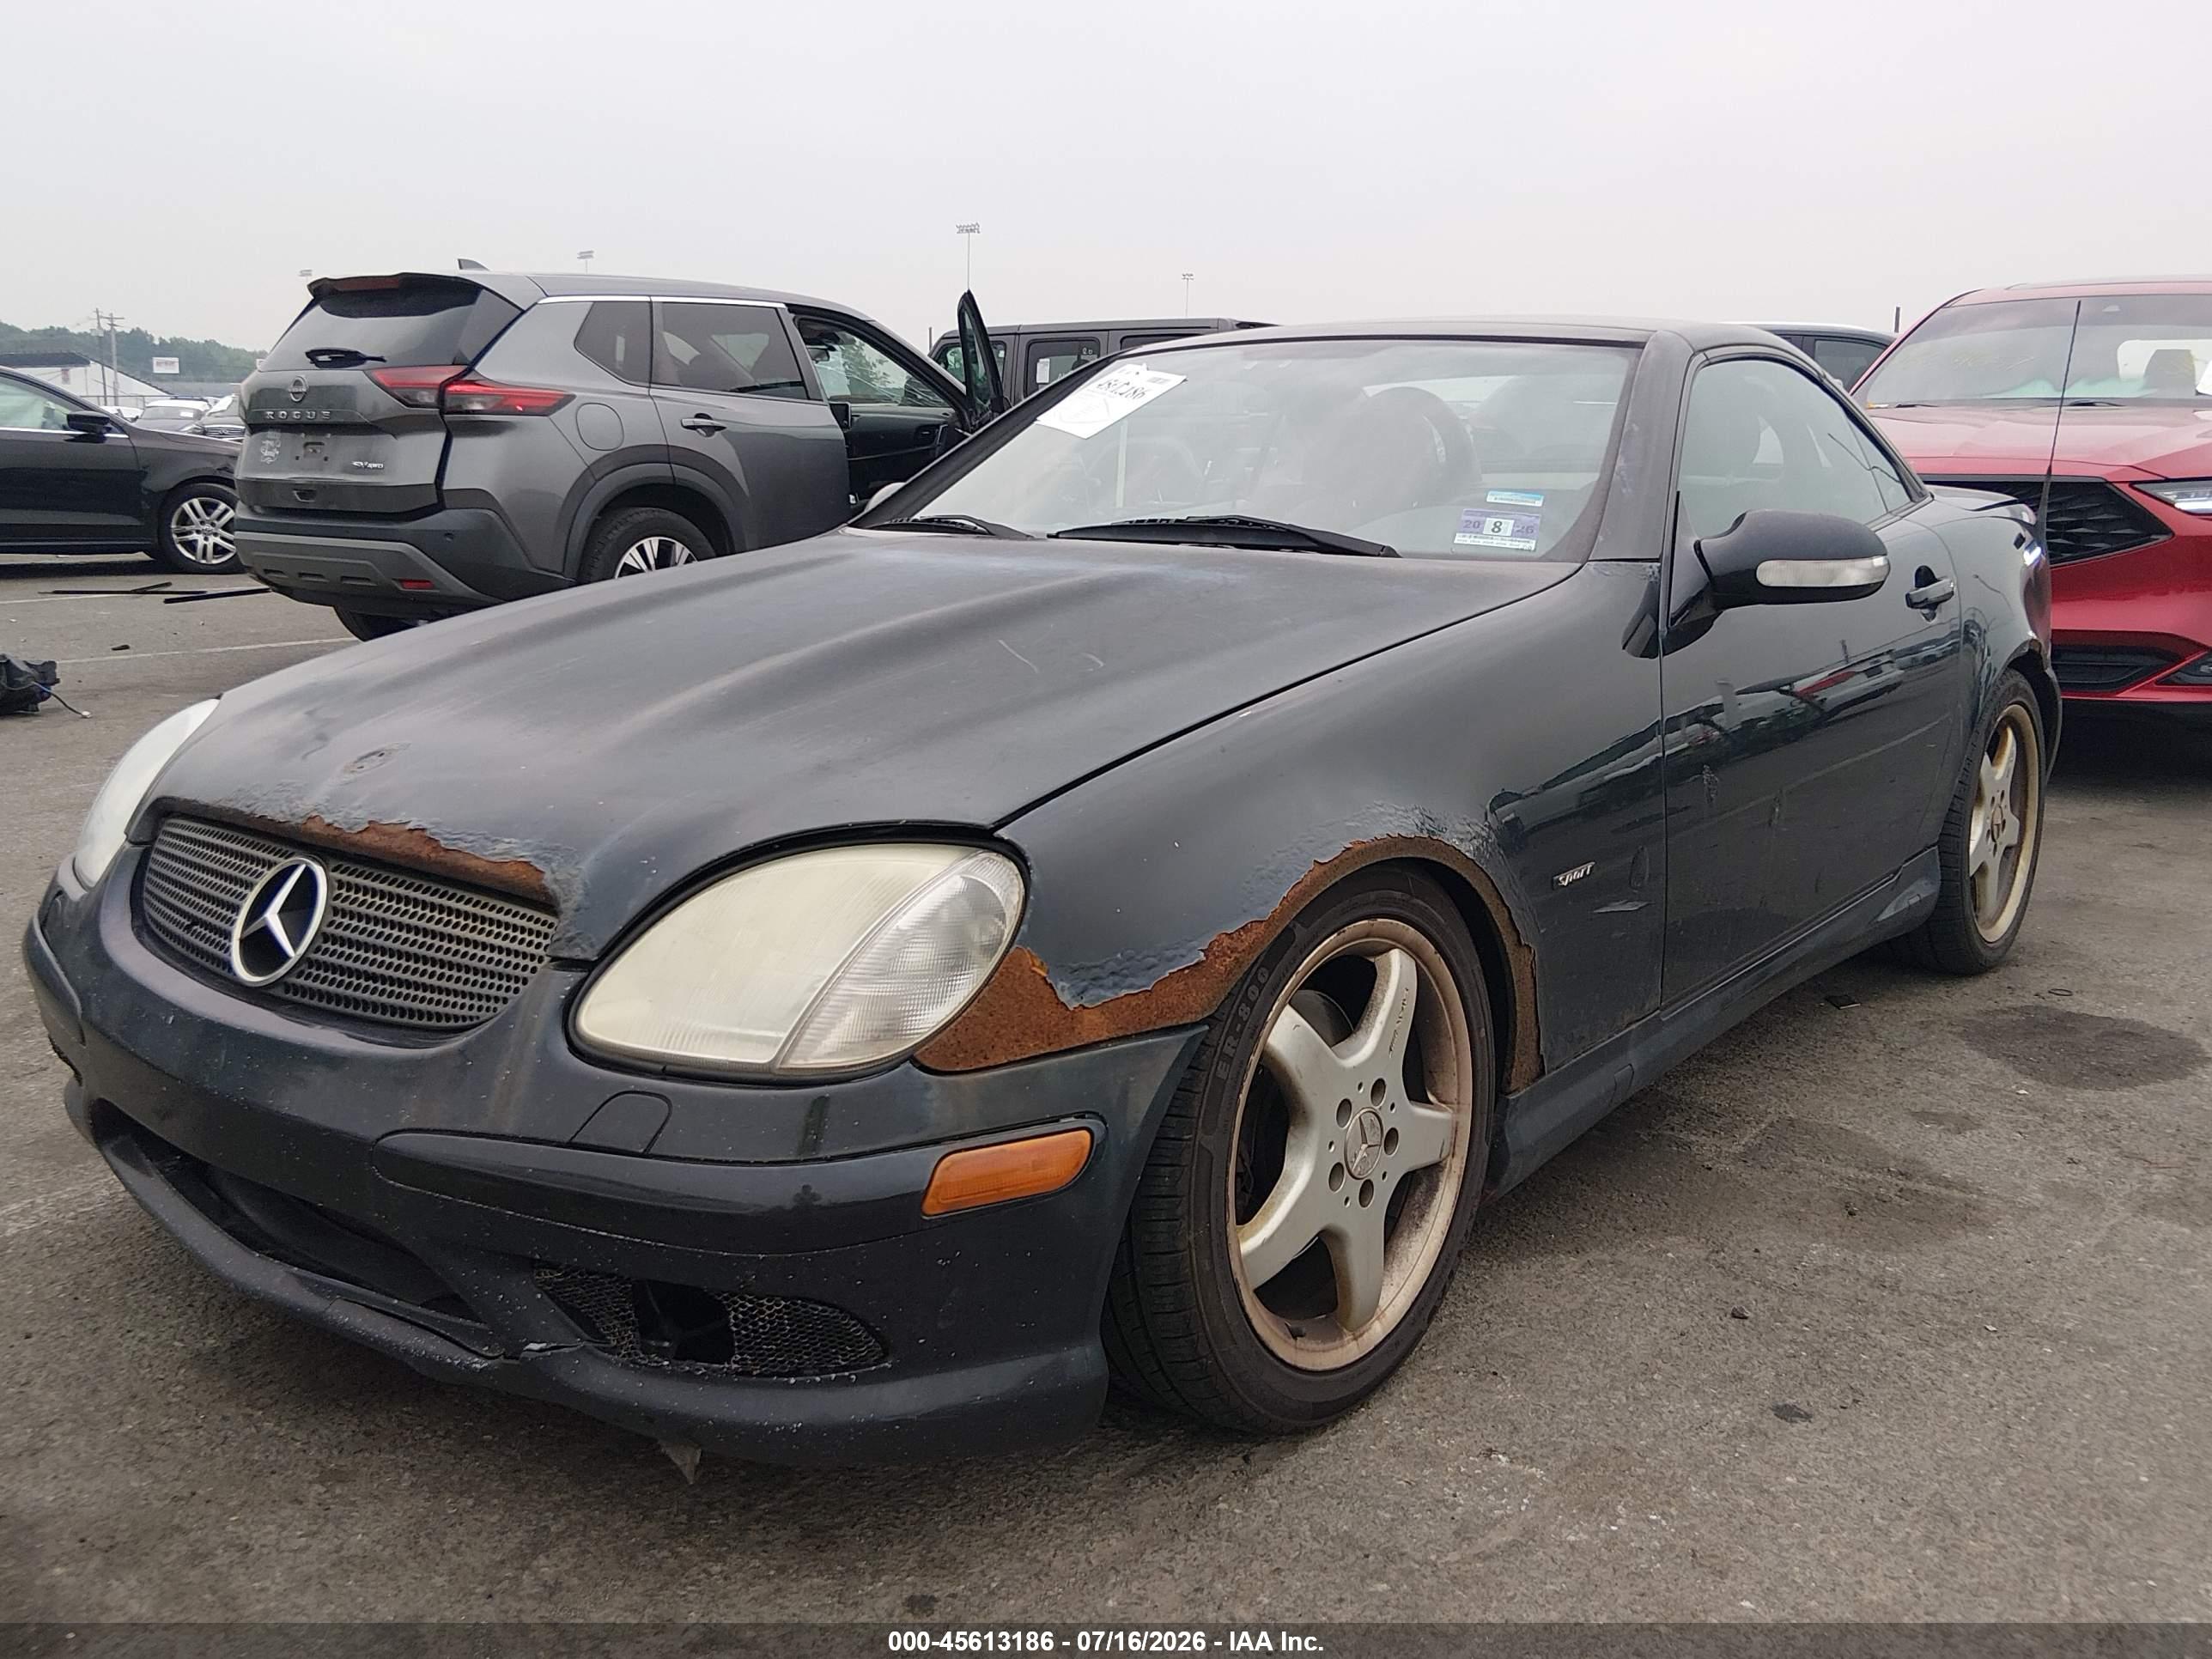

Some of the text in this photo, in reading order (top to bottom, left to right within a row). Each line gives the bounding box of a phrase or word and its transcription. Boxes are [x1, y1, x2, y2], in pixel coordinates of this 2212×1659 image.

[265, 410, 331, 420] ROGUE
[1463, 520, 1480, 529] 20
[1491, 520, 1503, 533] 8
